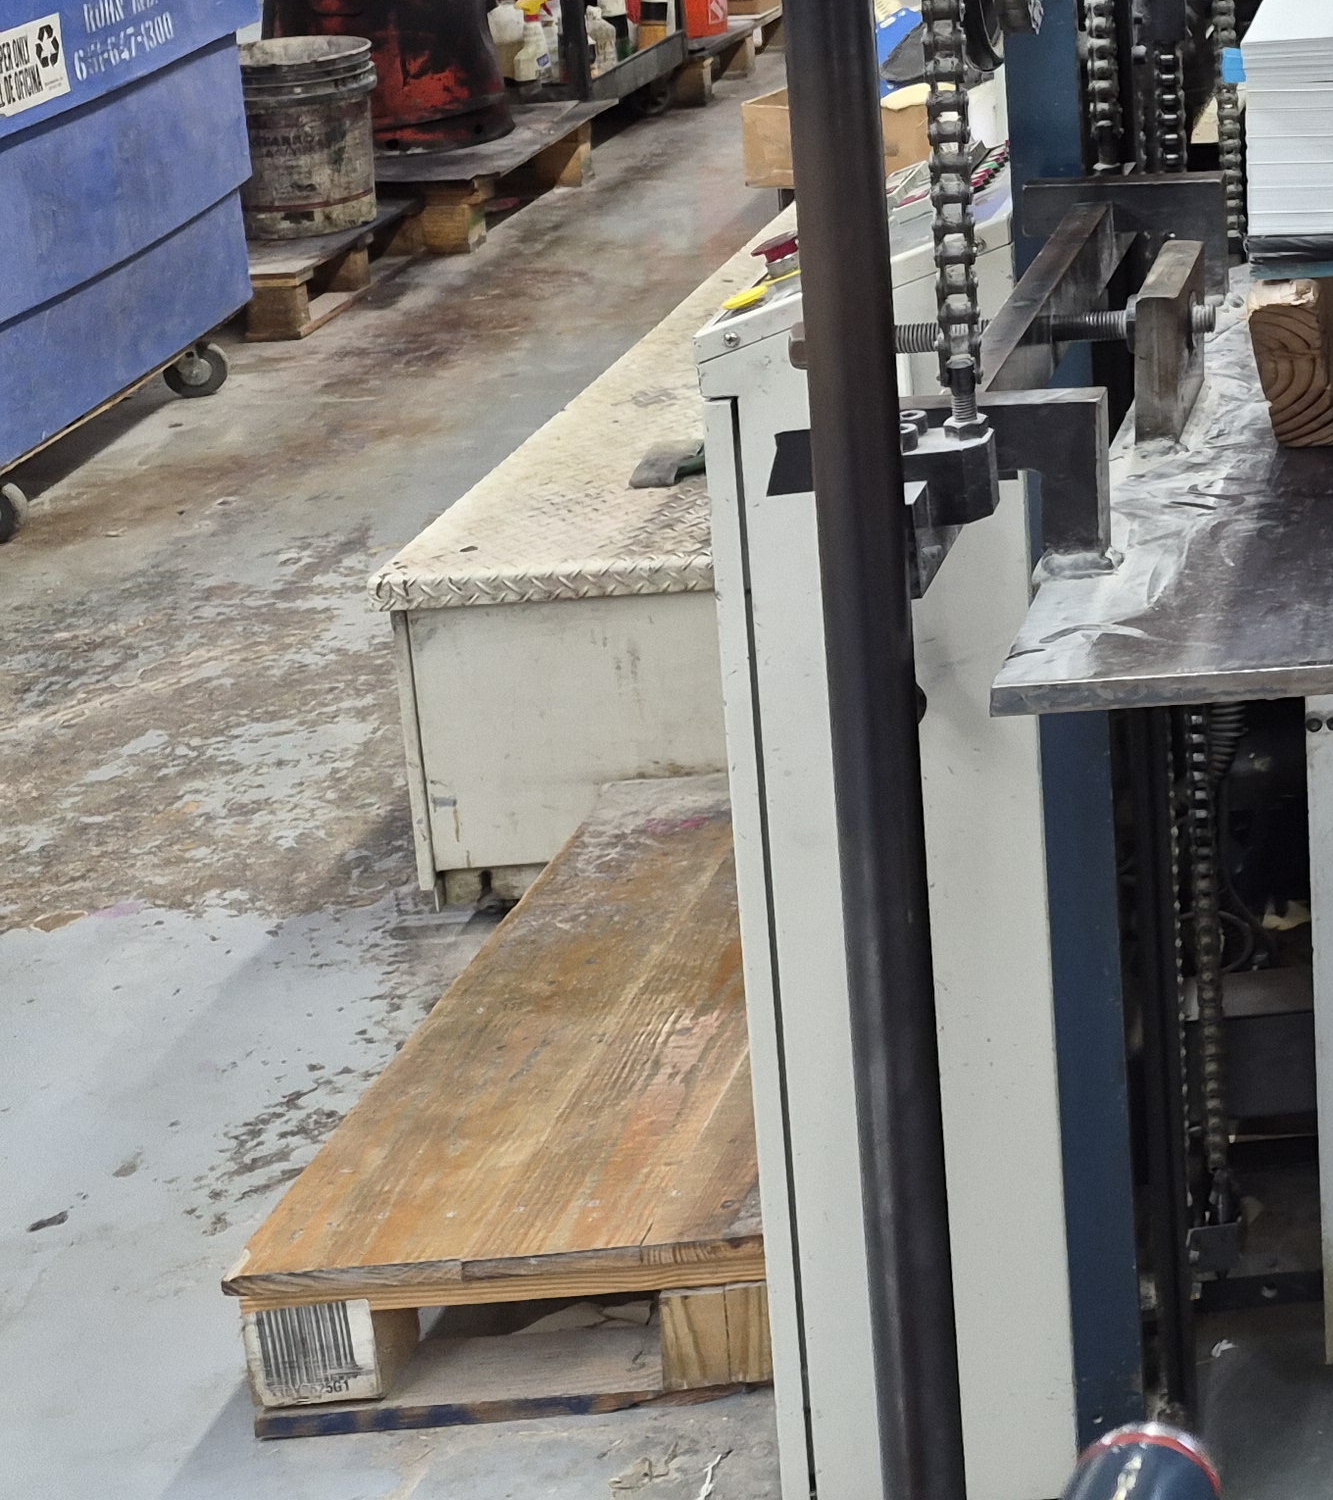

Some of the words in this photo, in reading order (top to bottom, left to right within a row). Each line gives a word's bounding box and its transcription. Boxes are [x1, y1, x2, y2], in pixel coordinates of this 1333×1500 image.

[12, 34, 30, 68] ONLY
[4, 73, 15, 105] DE
[14, 63, 43, 101] OFICINA
